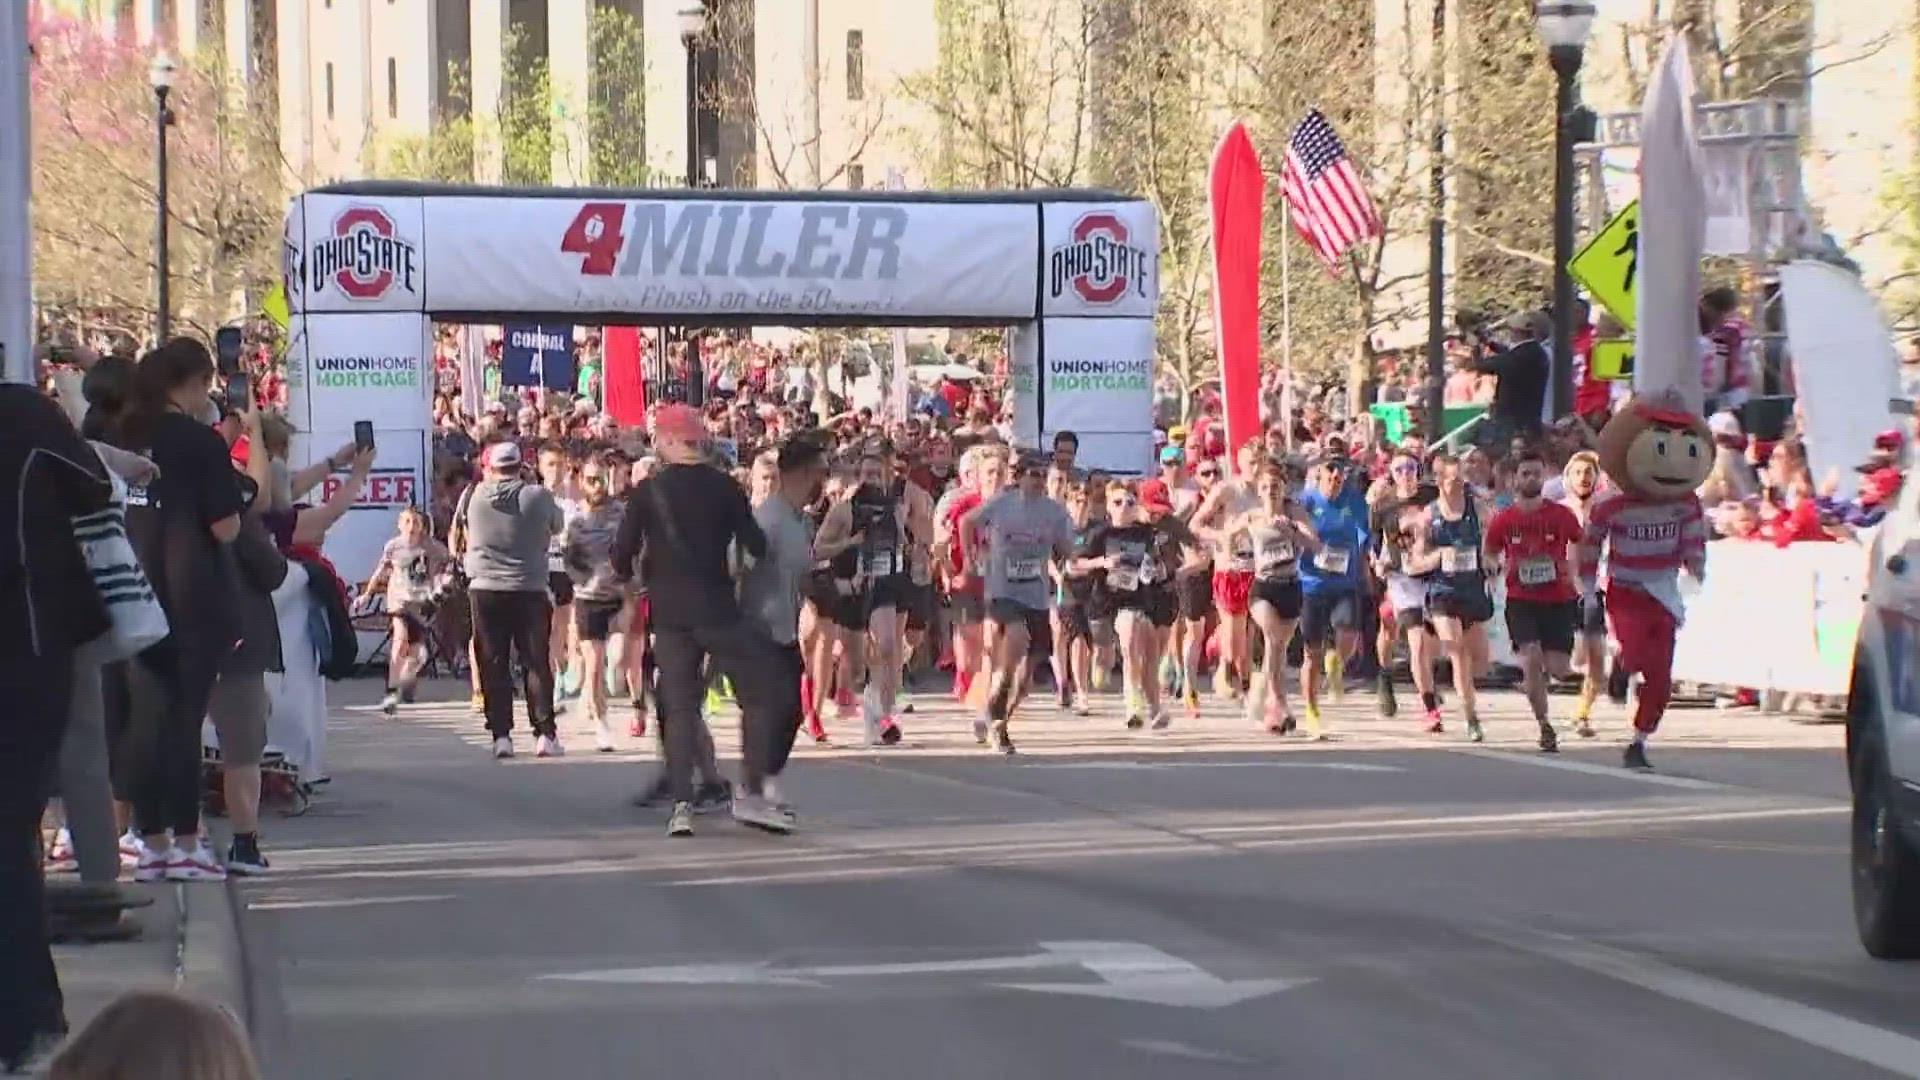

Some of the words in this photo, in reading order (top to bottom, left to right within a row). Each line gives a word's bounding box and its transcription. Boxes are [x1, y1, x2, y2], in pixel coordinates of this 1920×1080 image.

[641, 286, 711, 309] Finish
[720, 291, 748, 309] on
[756, 287, 791, 310] the
[315, 372, 418, 387] MORTGAGE
[1051, 375, 1148, 390] MORTGAGE
